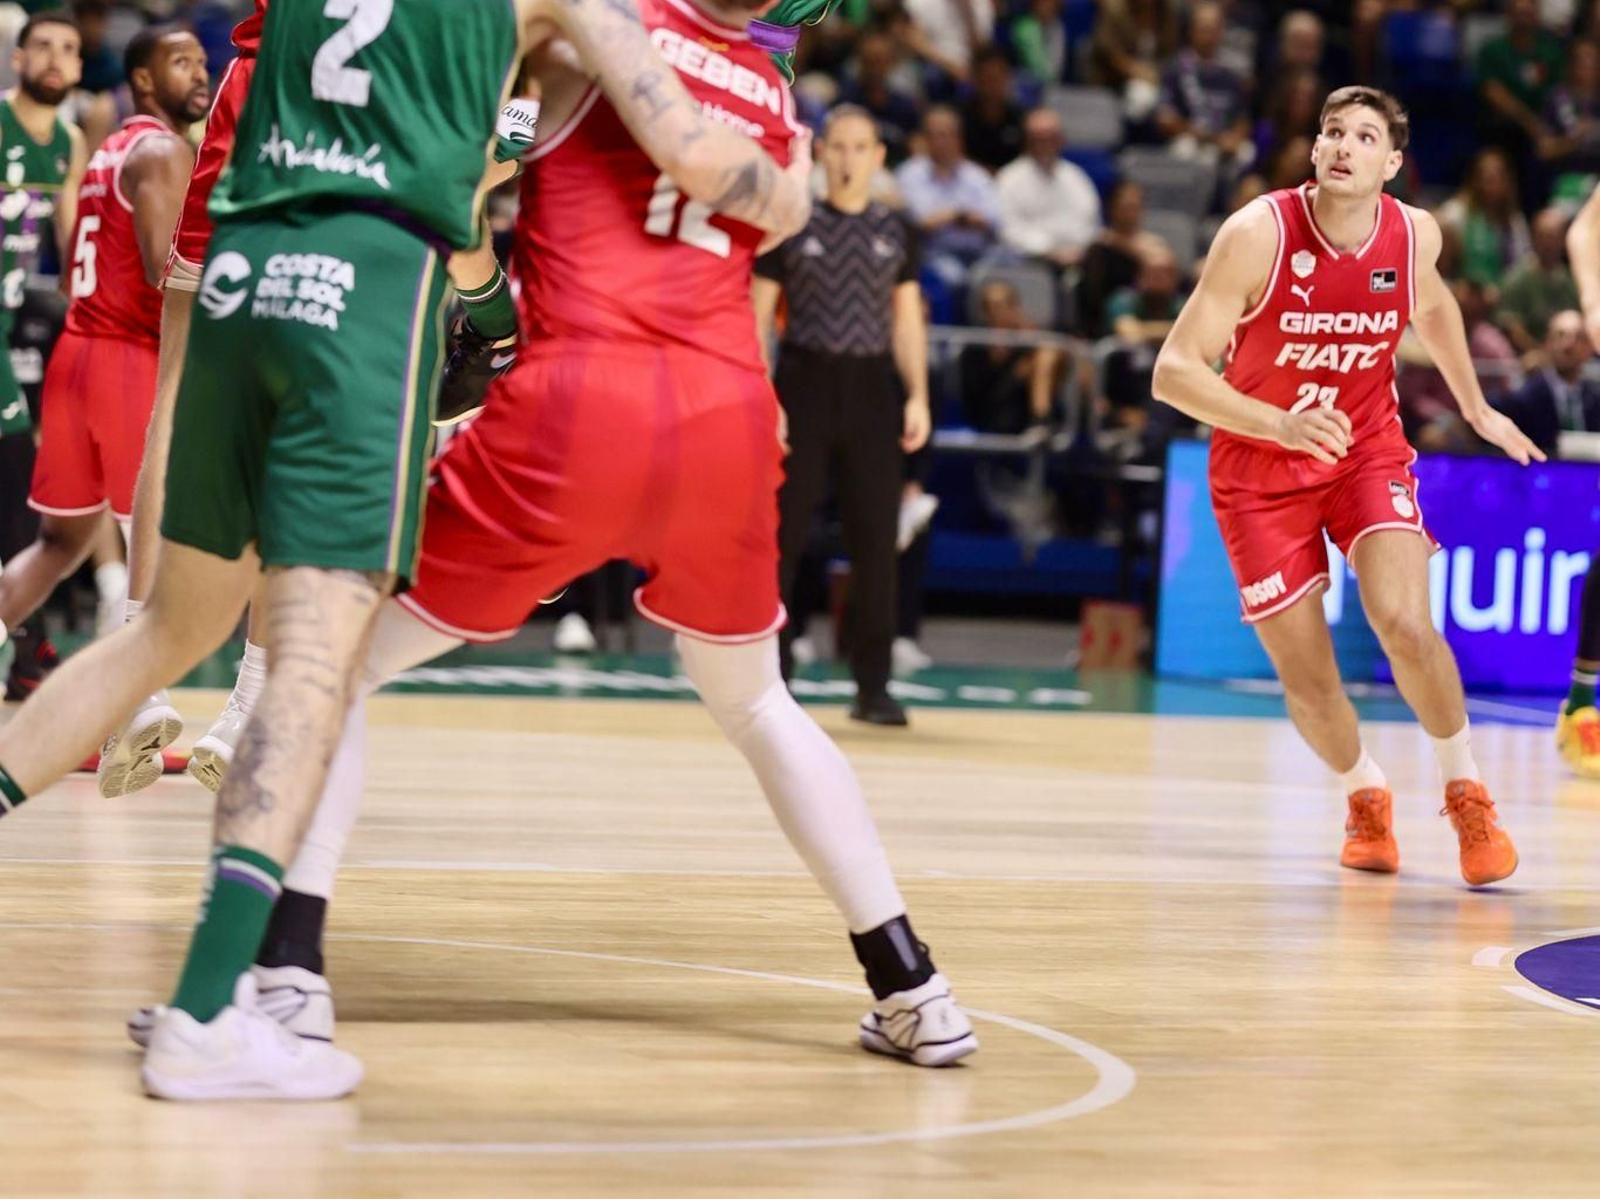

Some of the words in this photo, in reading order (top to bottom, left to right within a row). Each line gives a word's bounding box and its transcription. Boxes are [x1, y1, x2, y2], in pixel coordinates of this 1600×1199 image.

[650, 27, 781, 117] GEBEN
[71, 215, 101, 297] 5
[265, 253, 355, 292] COSTA
[1279, 309, 1398, 334] GIRONA
[1274, 341, 1390, 373] FIATC
